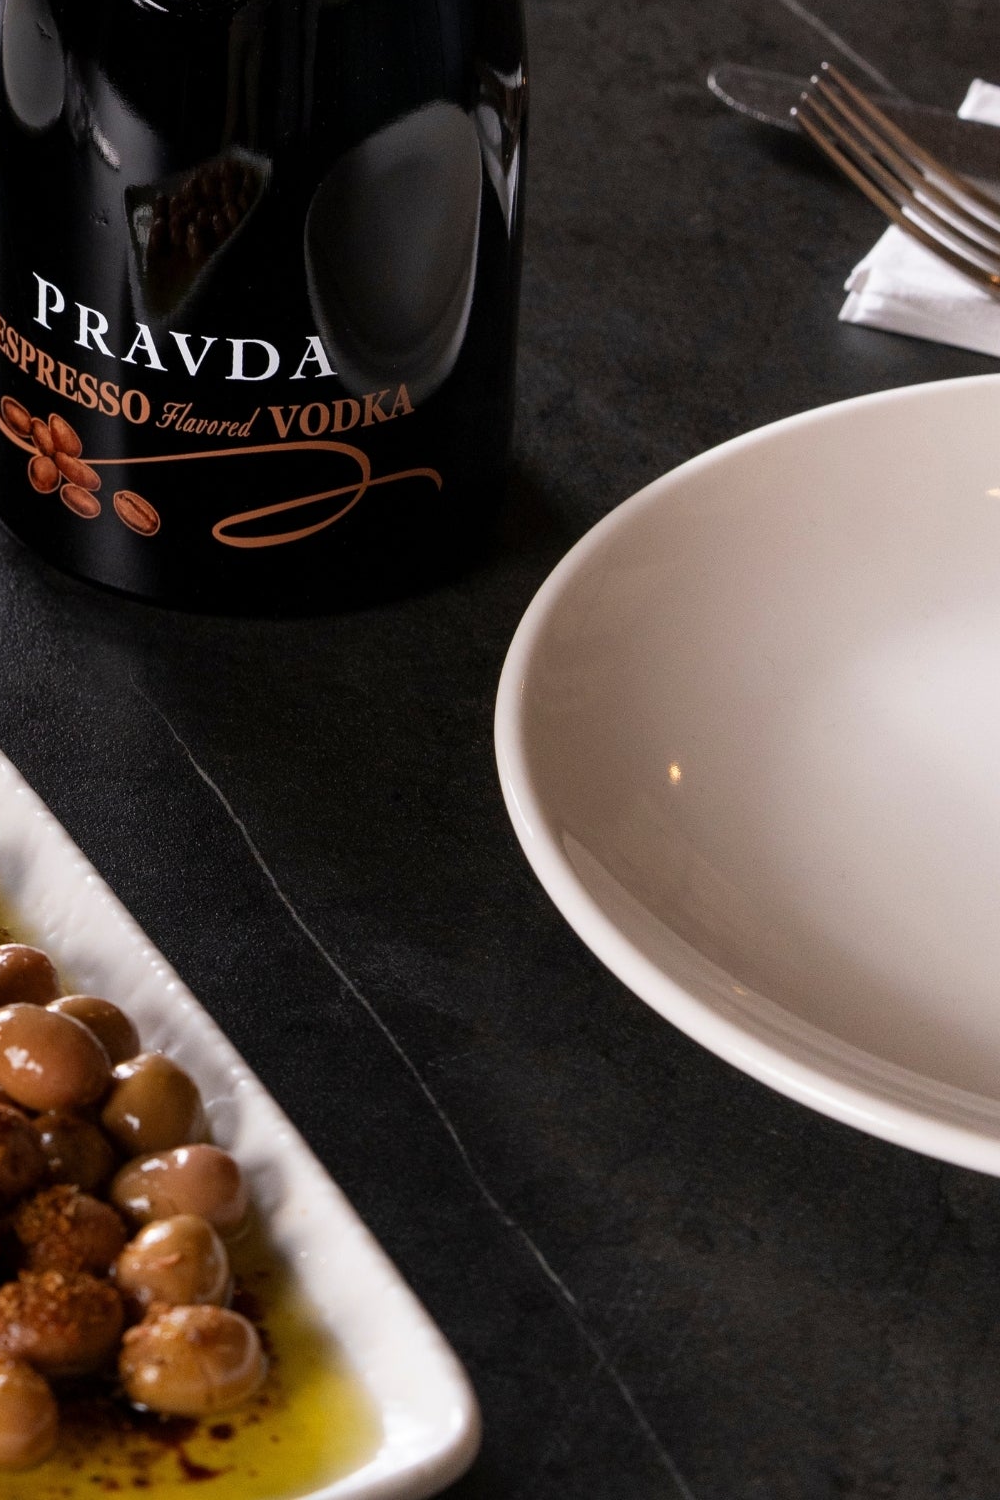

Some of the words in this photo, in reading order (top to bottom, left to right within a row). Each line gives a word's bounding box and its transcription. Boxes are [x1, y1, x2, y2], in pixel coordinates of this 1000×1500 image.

[33, 272, 338, 381] PRAVDA
[155, 402, 261, 439] Flavored
[268, 384, 415, 439] VODKA
